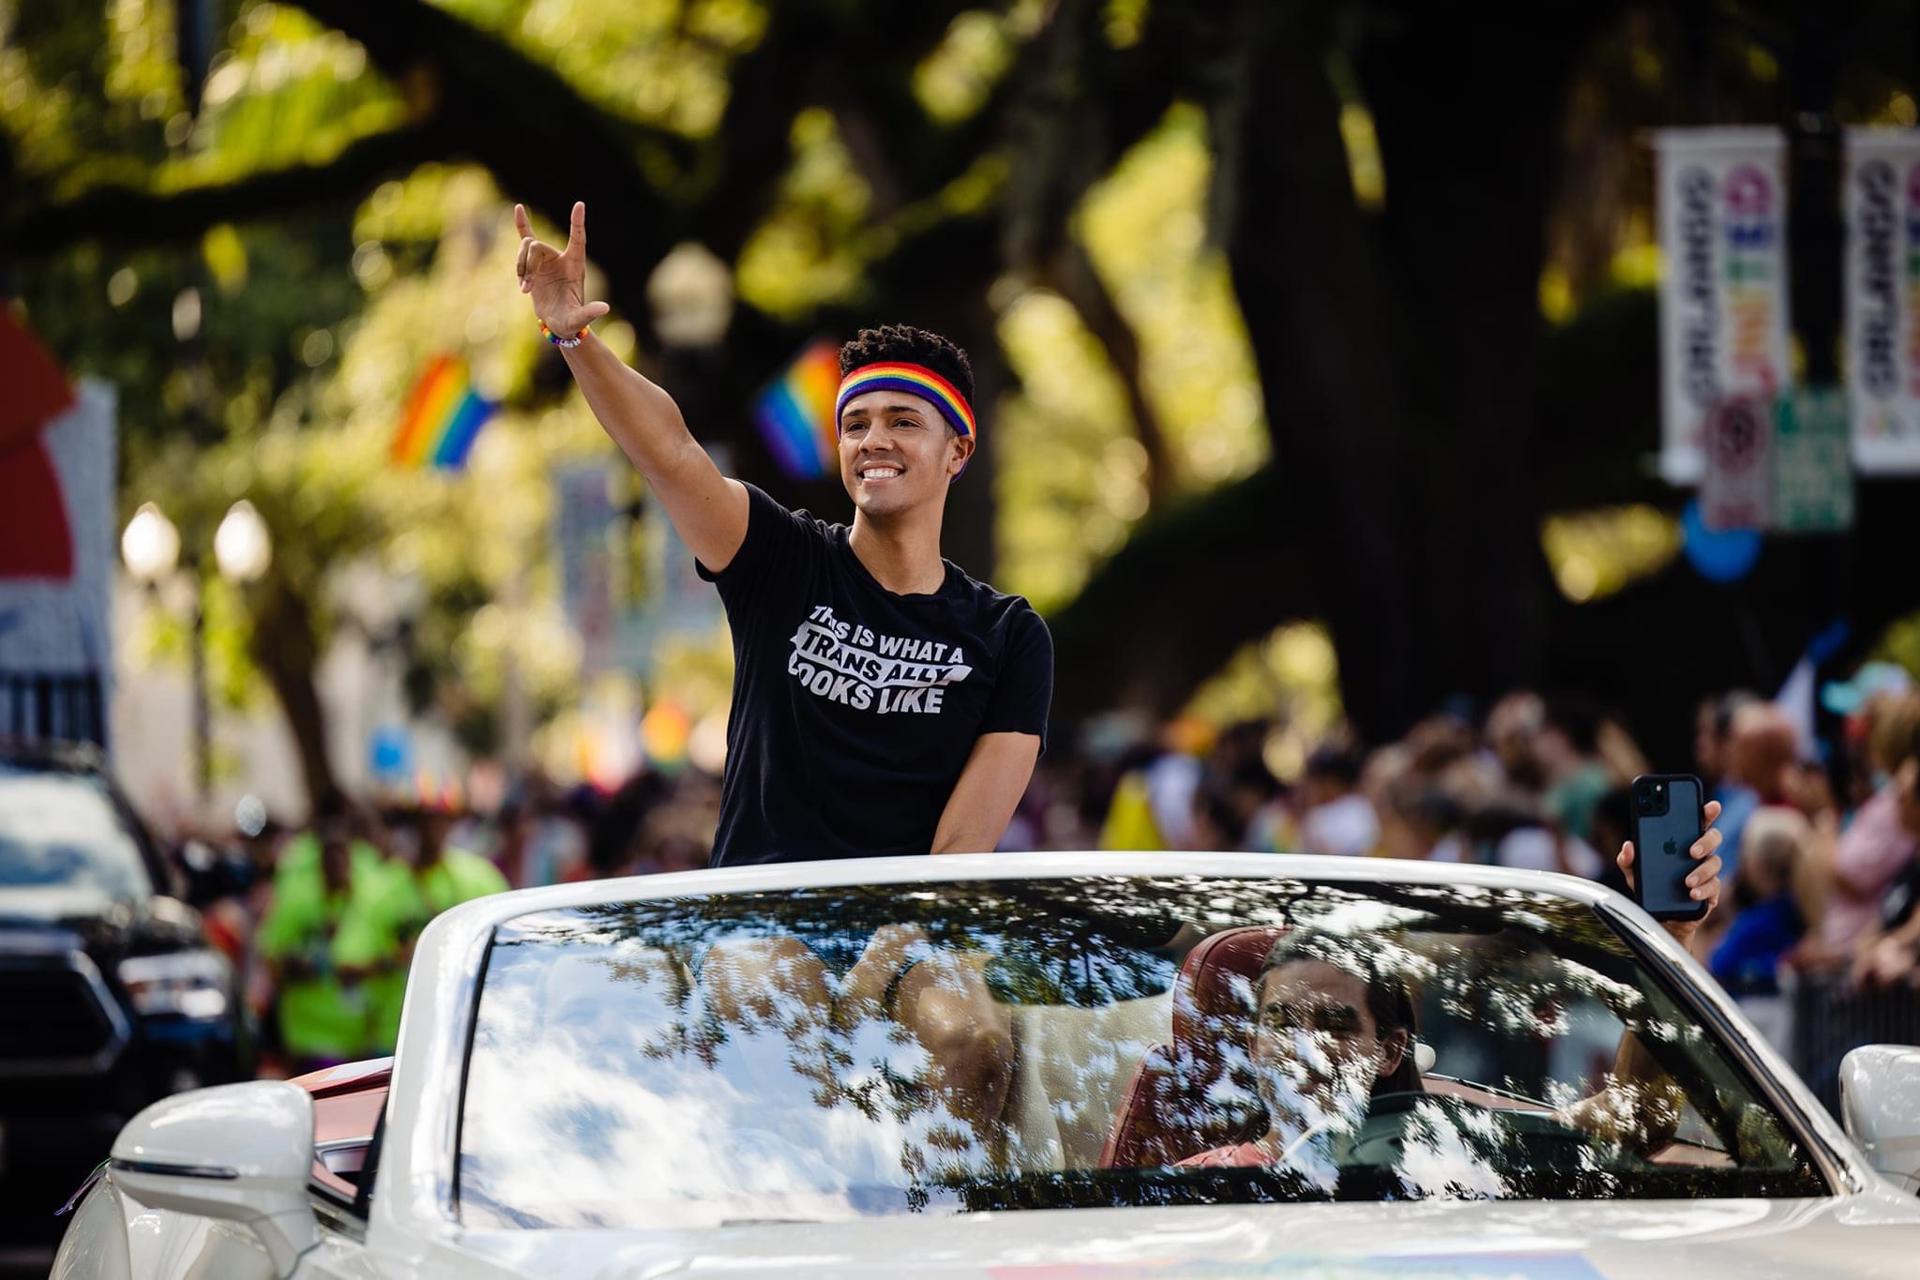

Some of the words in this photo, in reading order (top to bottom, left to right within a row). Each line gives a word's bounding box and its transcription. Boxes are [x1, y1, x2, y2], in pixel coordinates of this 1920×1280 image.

[1723, 164, 1774, 398] UNITED
[1859, 161, 1899, 398] ORLANDO
[800, 629, 882, 681] TRANS
[884, 664, 953, 682] ALLY
[852, 625, 874, 646] IS
[879, 635, 948, 661] WHAT
[948, 648, 964, 663] A
[788, 650, 874, 710] LOOKS
[877, 688, 943, 713] LIKE
